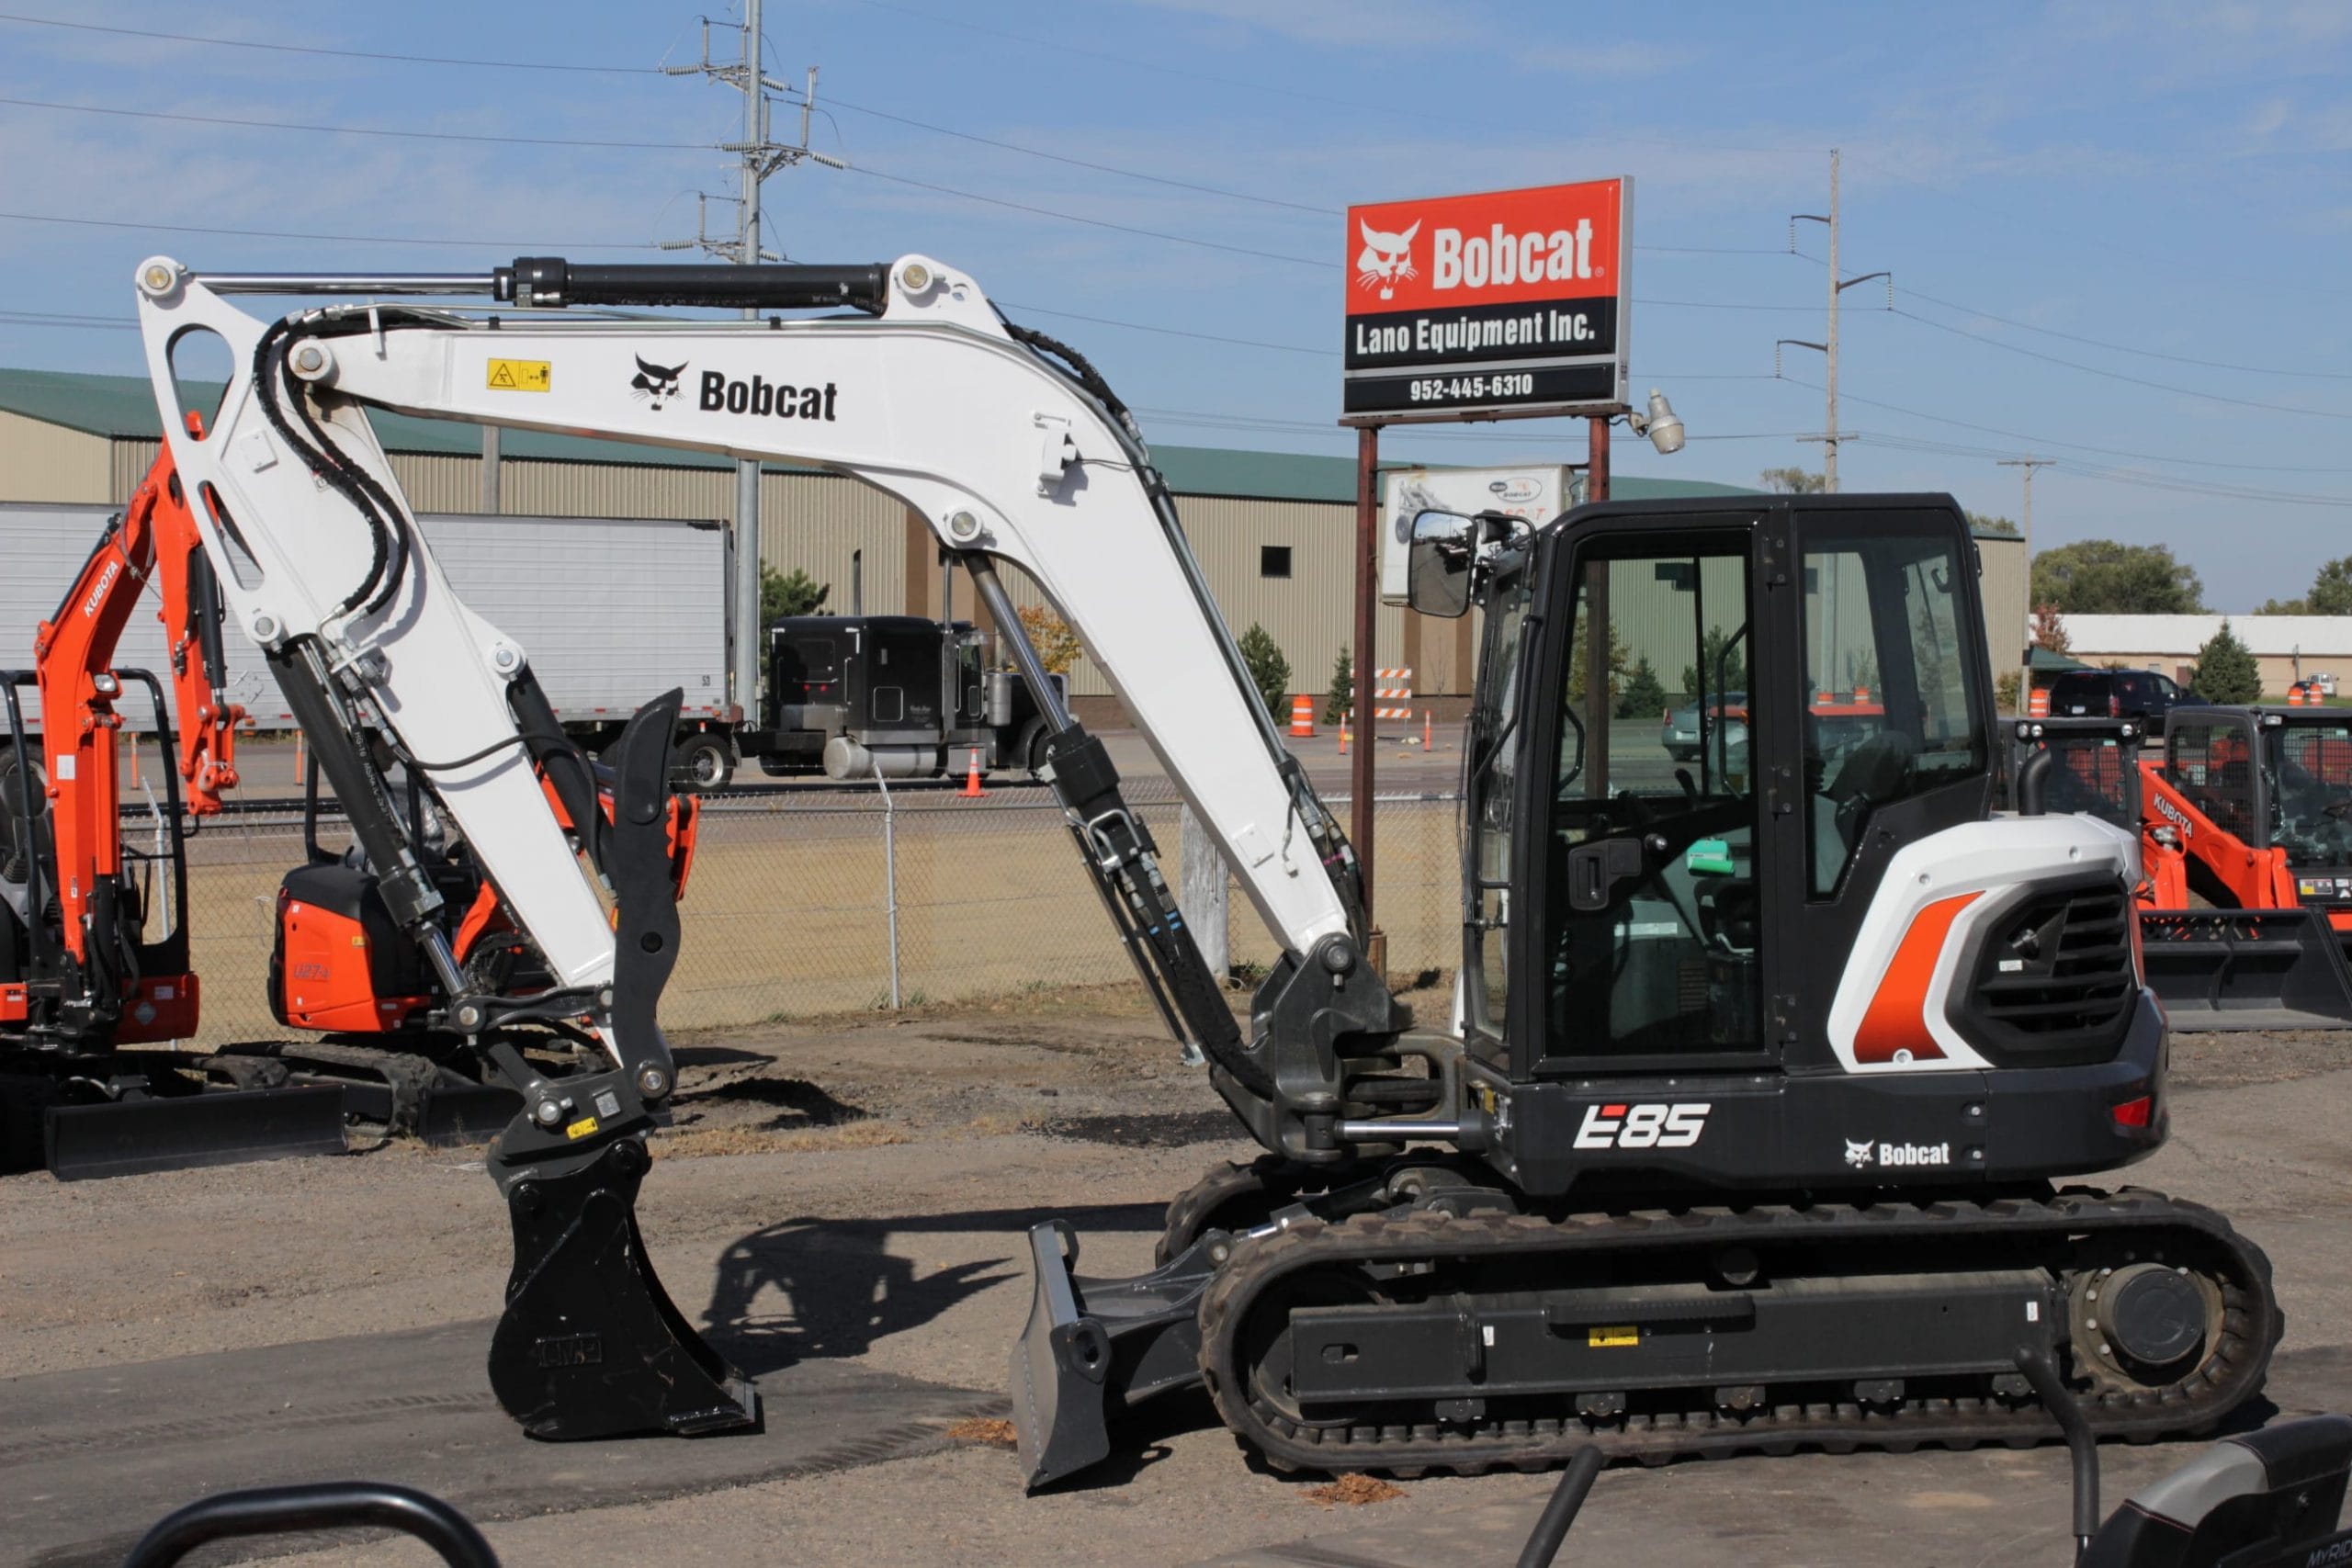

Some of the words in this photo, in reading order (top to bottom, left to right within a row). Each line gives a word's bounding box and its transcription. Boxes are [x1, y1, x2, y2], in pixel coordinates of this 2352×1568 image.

[1433, 219, 1592, 290] Bobcat
[1356, 323, 1409, 355] Lano
[1416, 312, 1543, 353] Equipment
[1549, 310, 1595, 341] Inc.
[699, 370, 837, 422] Bobcat
[1410, 374, 1532, 401] 952-445-6310
[84, 559, 119, 618] KUBOTA
[2154, 792, 2192, 838] KUBOTA
[1572, 1103, 1712, 1149] E85
[1879, 1142, 1950, 1166] Bobcat
